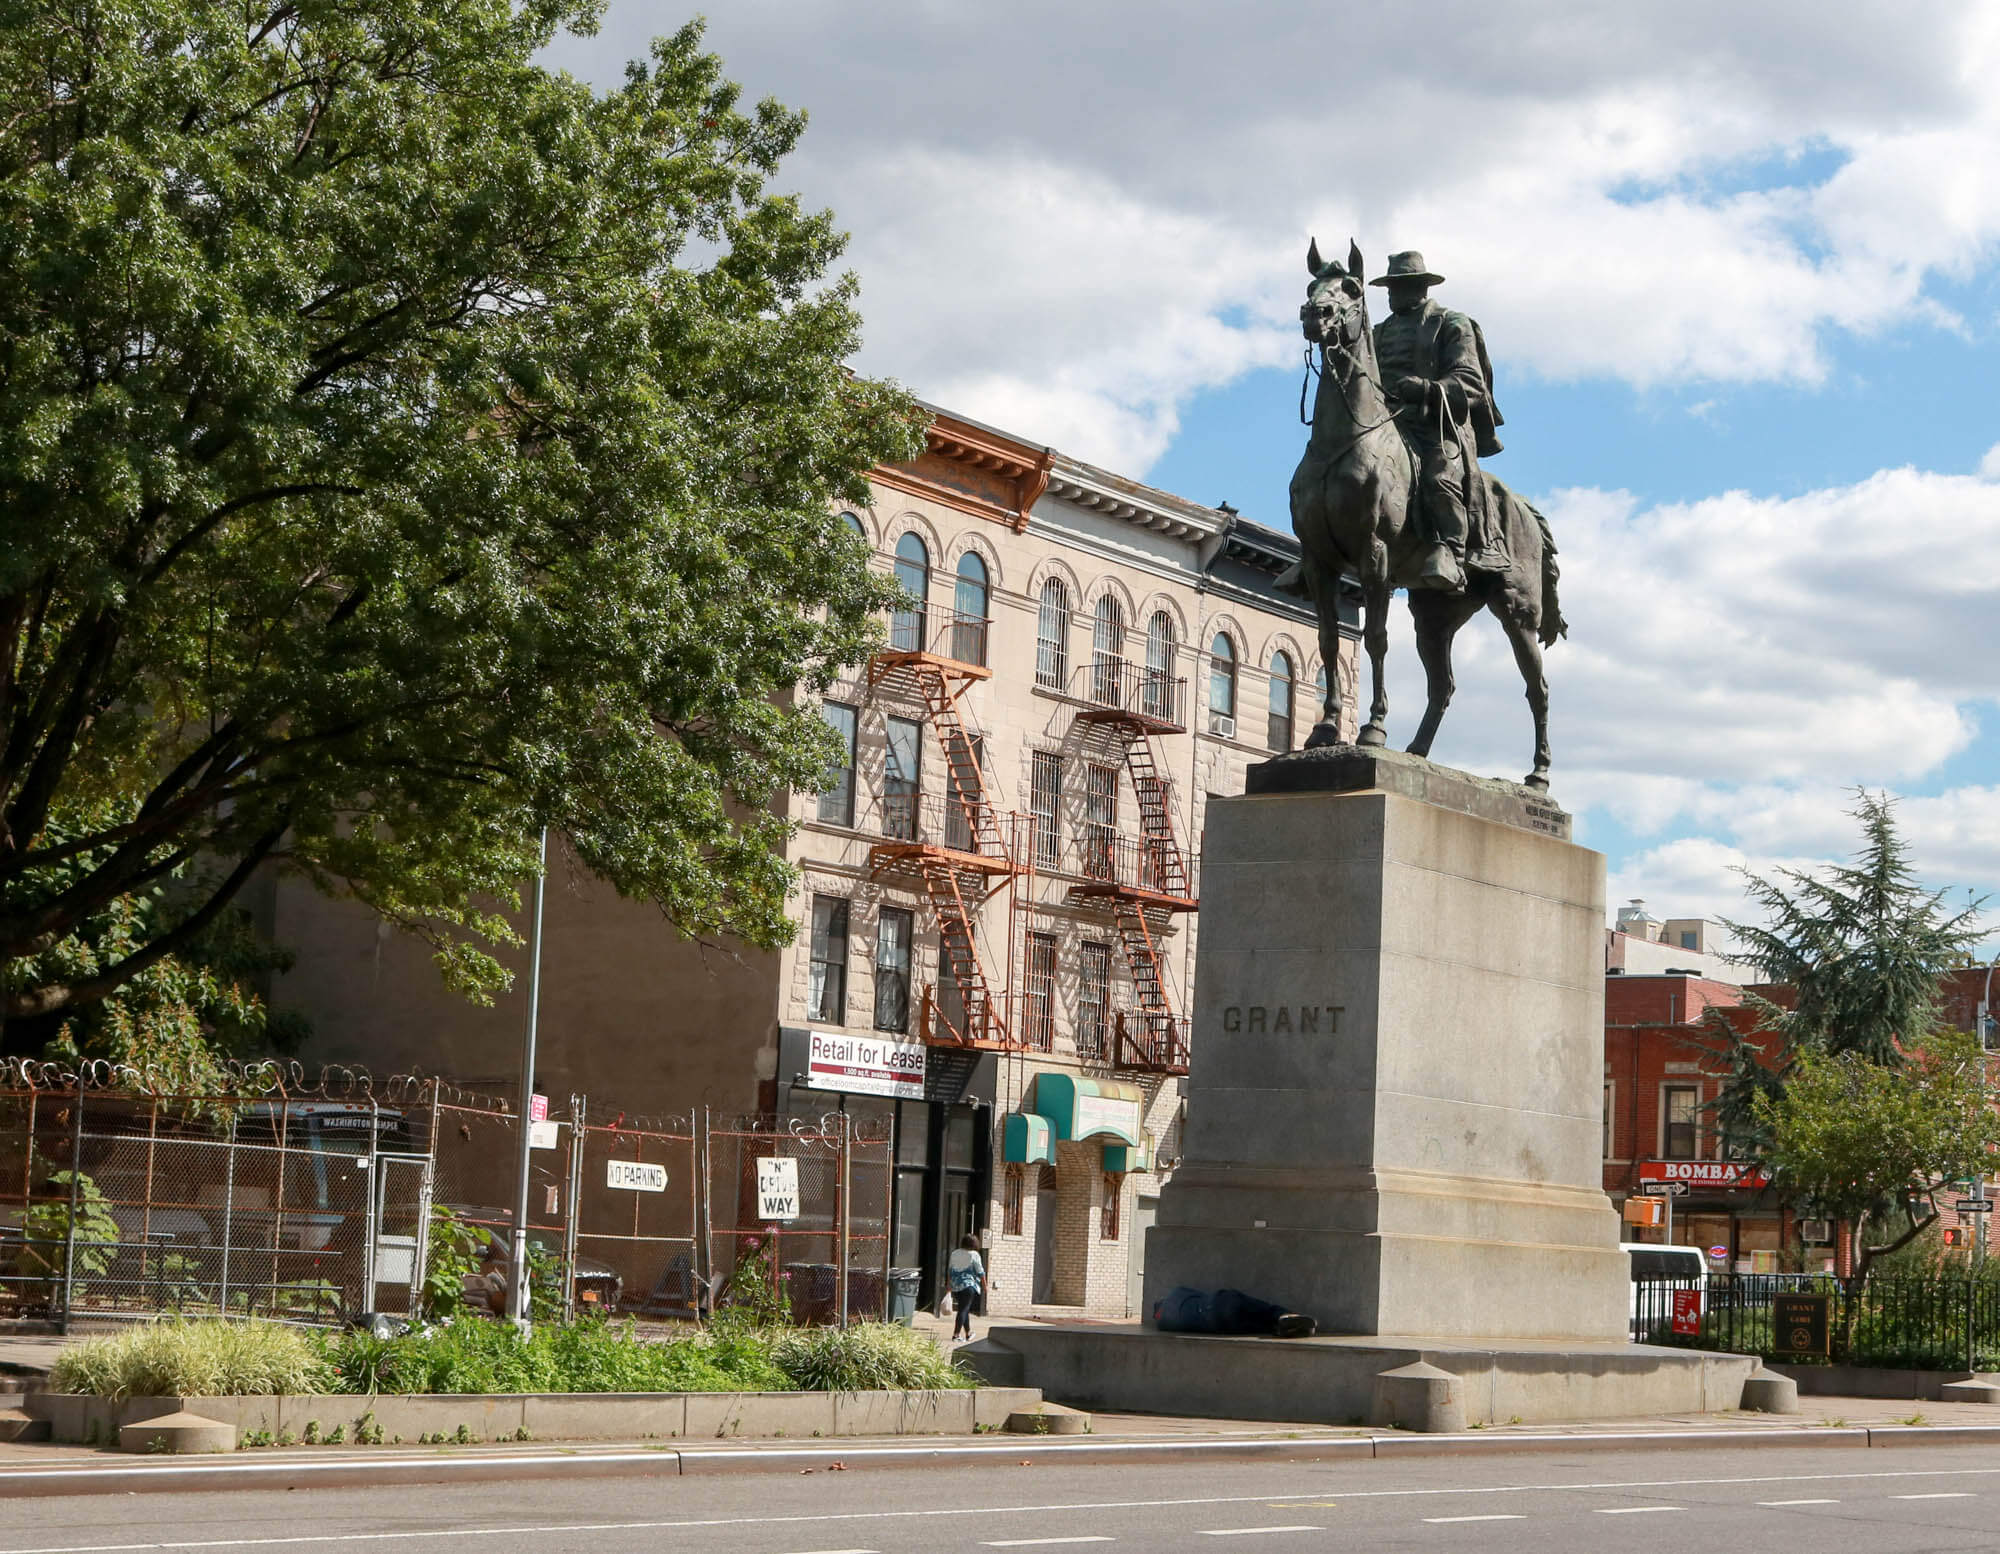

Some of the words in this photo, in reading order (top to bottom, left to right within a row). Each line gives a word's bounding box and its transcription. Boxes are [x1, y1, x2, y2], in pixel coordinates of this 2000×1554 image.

[1223, 1006, 1345, 1033] GRANT
[811, 1037, 853, 1061] Retail
[858, 1043, 877, 1064] for
[882, 1045, 923, 1070] Lease
[376, 1120, 398, 1129] EMPLE
[624, 1166, 662, 1188] PARKING
[763, 1197, 793, 1214] WAY
